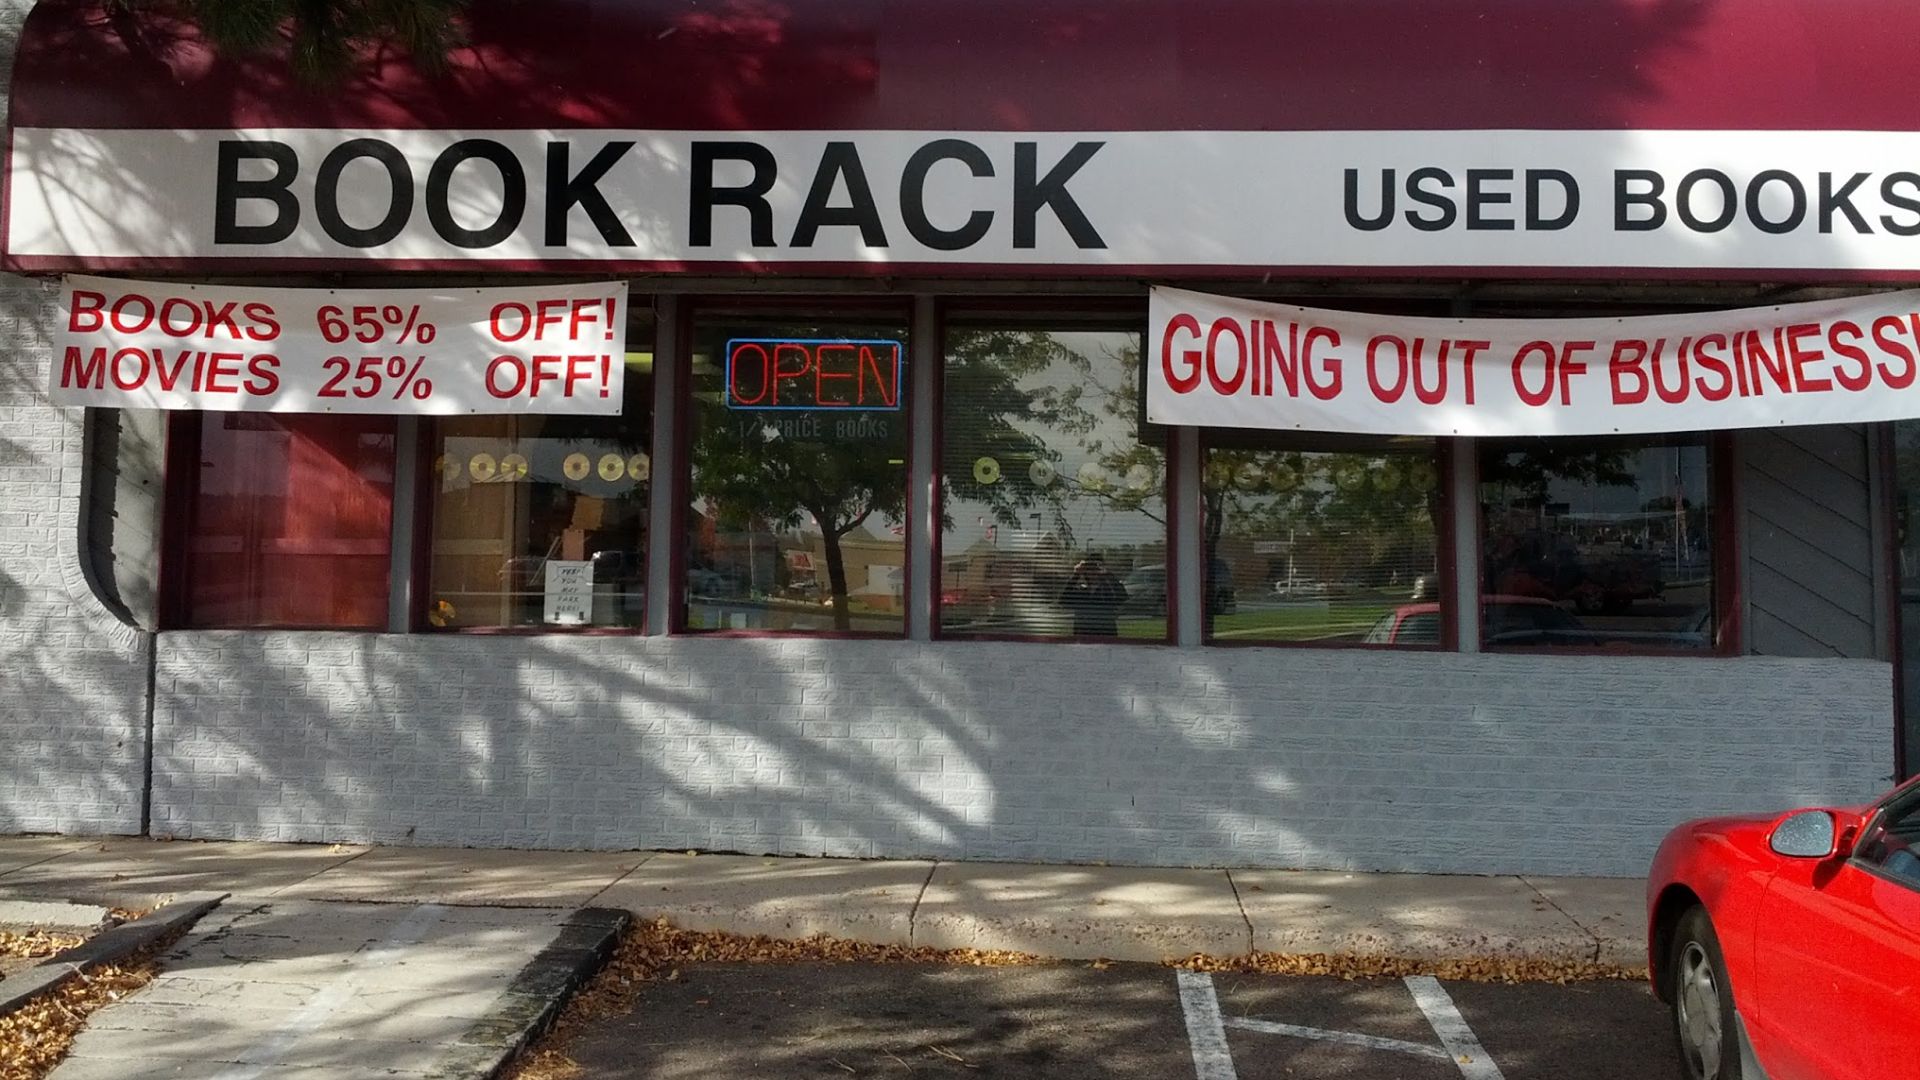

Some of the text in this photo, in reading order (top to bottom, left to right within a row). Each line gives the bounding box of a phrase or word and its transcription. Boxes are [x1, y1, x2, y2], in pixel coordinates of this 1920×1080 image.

[214, 139, 1108, 250] BOOK RACK
[1345, 168, 1920, 236] USED BOOKS
[69, 291, 617, 345] BOOKS 65% OFF!
[61, 347, 612, 400] MOVIES 25% OFF!
[732, 343, 898, 405] OPEN
[1162, 314, 1343, 401] GOING
[1366, 334, 1491, 406] OUT
[1512, 340, 1596, 408] OF
[774, 417, 822, 438] PRICE
[835, 418, 889, 439] BOOKS
